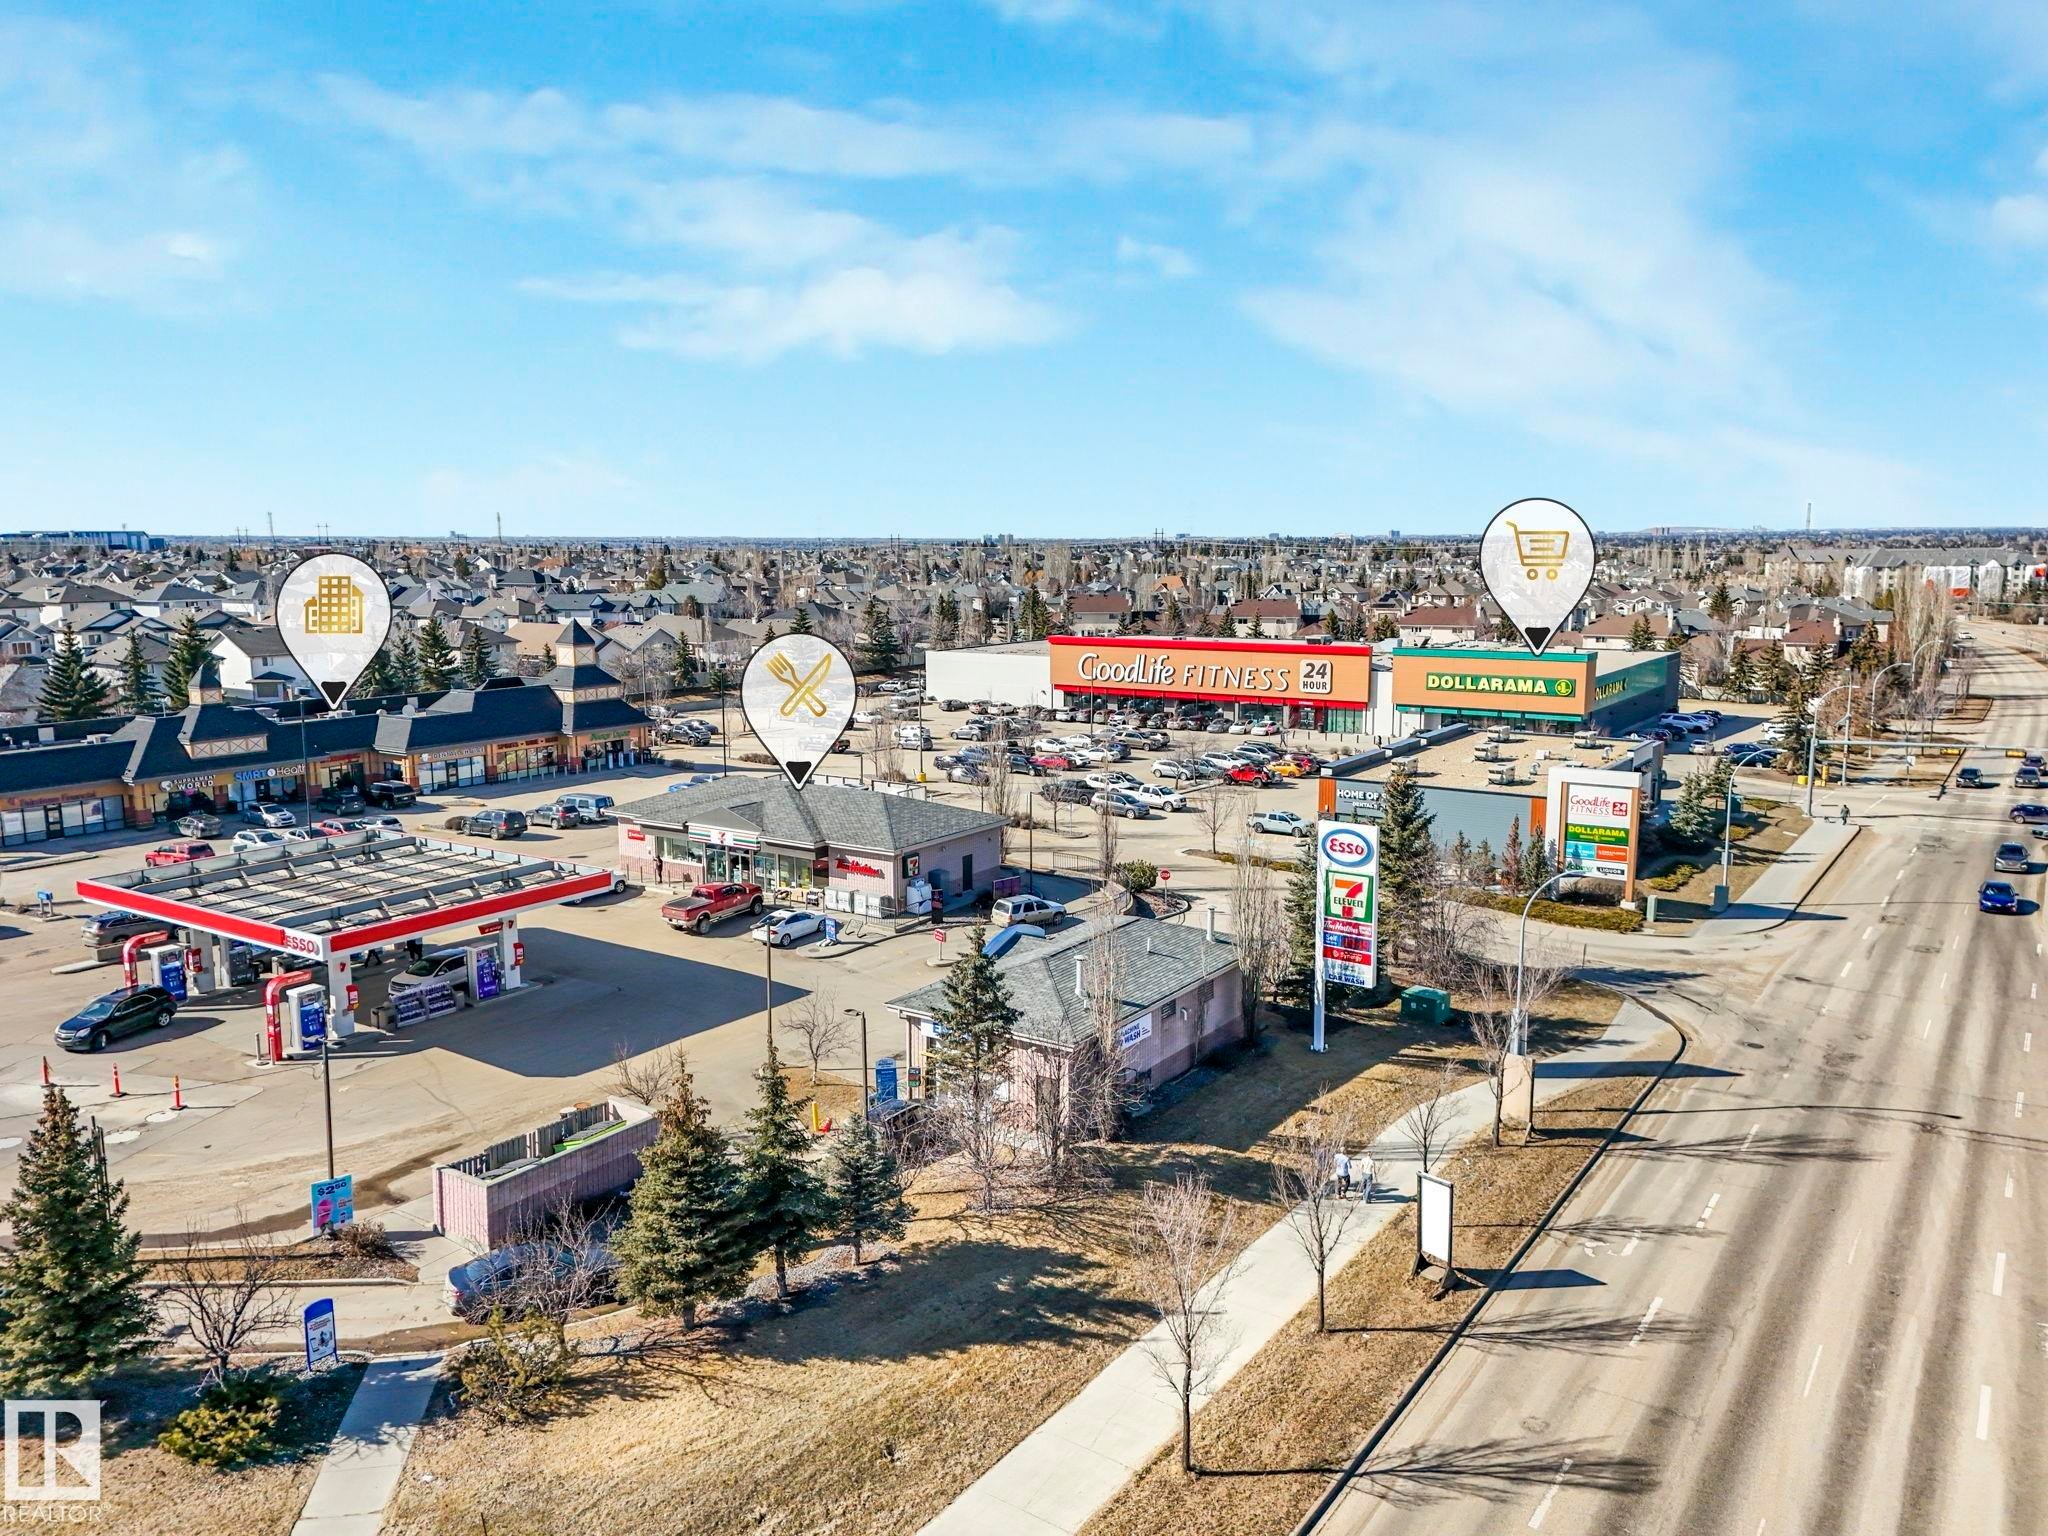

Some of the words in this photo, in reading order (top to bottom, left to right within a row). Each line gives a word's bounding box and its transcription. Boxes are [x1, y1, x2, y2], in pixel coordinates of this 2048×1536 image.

[1077, 652, 1175, 685] GoodLife
[1183, 663, 1291, 691] FITNESS
[1303, 662, 1328, 679] 24
[1302, 680, 1328, 691] HOUR
[1427, 674, 1548, 694] DOLLARAMA
[1595, 680, 1623, 700] OLLARAMA
[174, 775, 216, 785] SUPPLEMENT
[235, 769, 266, 781] SMRT
[177, 780, 214, 791] WORLD
[1336, 789, 1364, 799] HOME
[1366, 792, 1379, 800] OF
[1570, 795, 1611, 808] GoodLife
[1613, 803, 1627, 812] 24
[1570, 805, 1610, 816] FITNESS
[1568, 825, 1626, 837] DOLLARAMA
[1328, 973, 1343, 982] CAR
[1343, 975, 1365, 986] WASH
[1124, 1030, 1141, 1044] WASH
